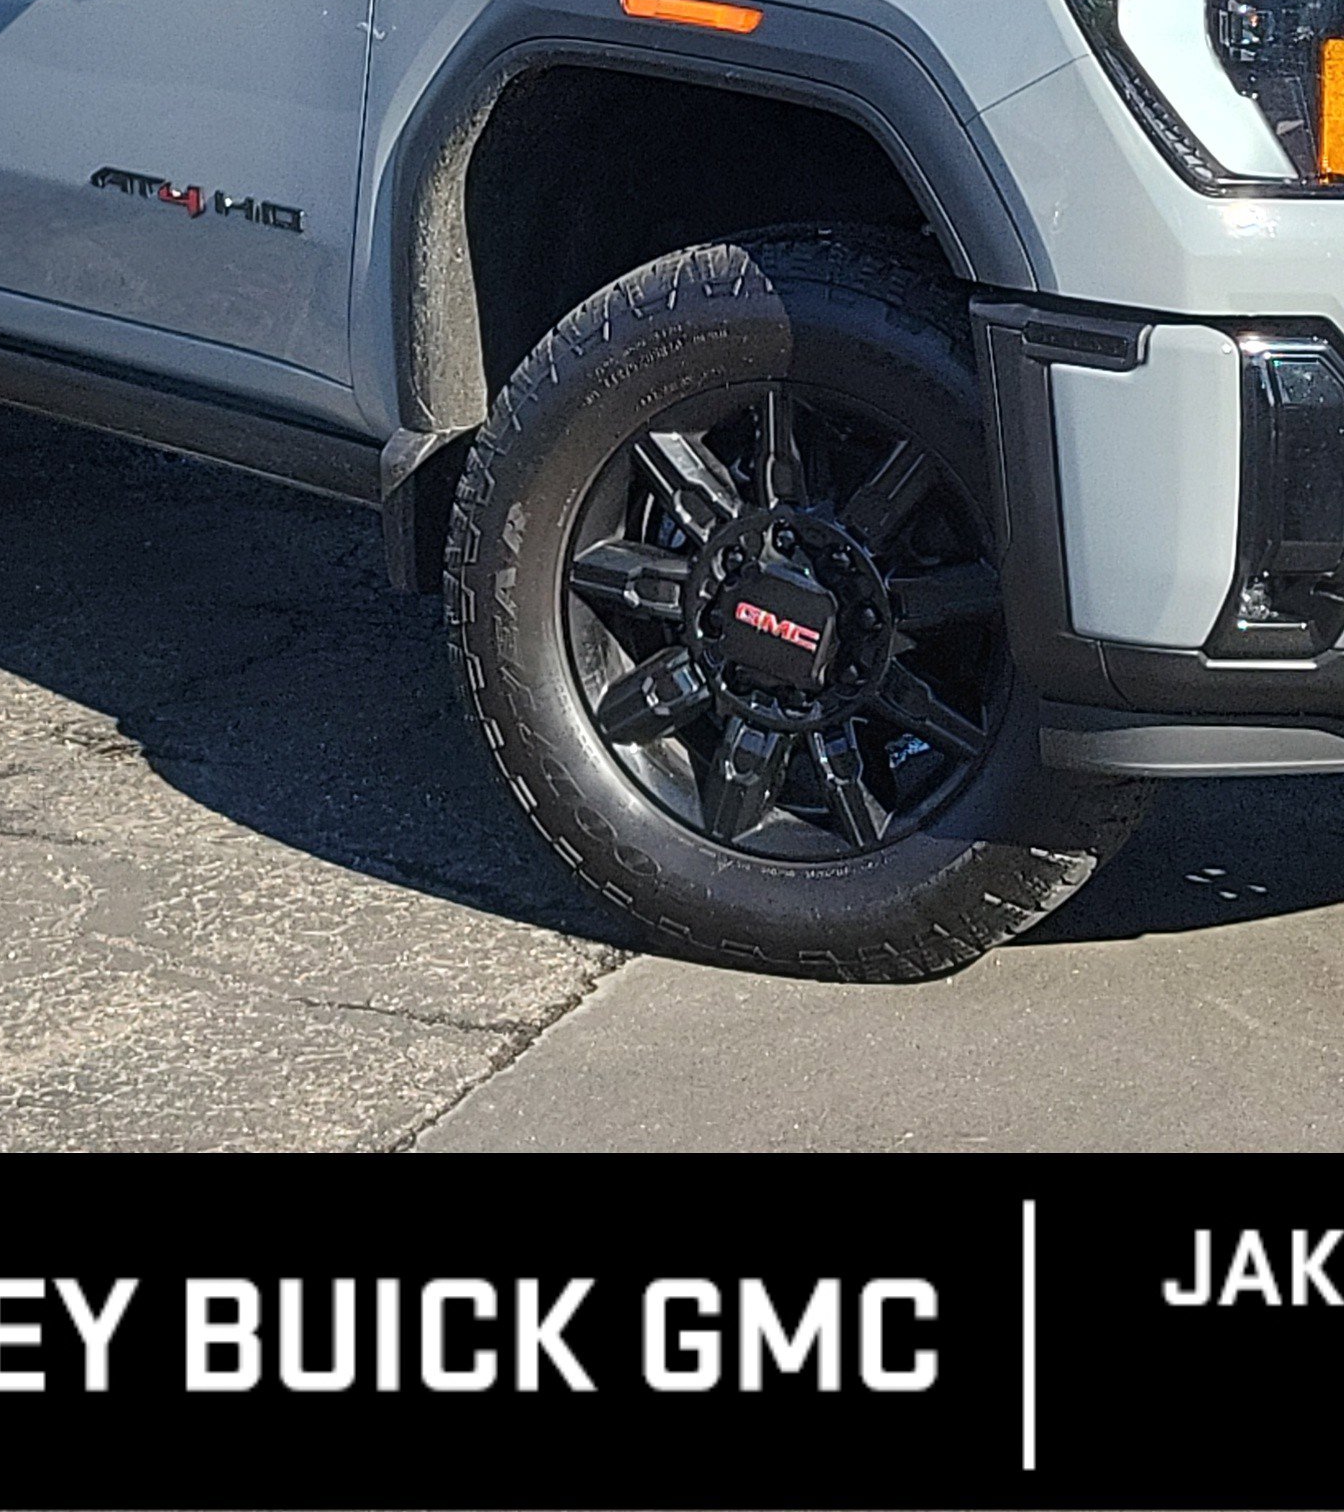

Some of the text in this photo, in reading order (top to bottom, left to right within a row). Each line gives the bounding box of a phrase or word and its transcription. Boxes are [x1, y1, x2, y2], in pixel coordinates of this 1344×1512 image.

[90, 165, 306, 234] AT4 HD
[734, 601, 820, 654] GMC
